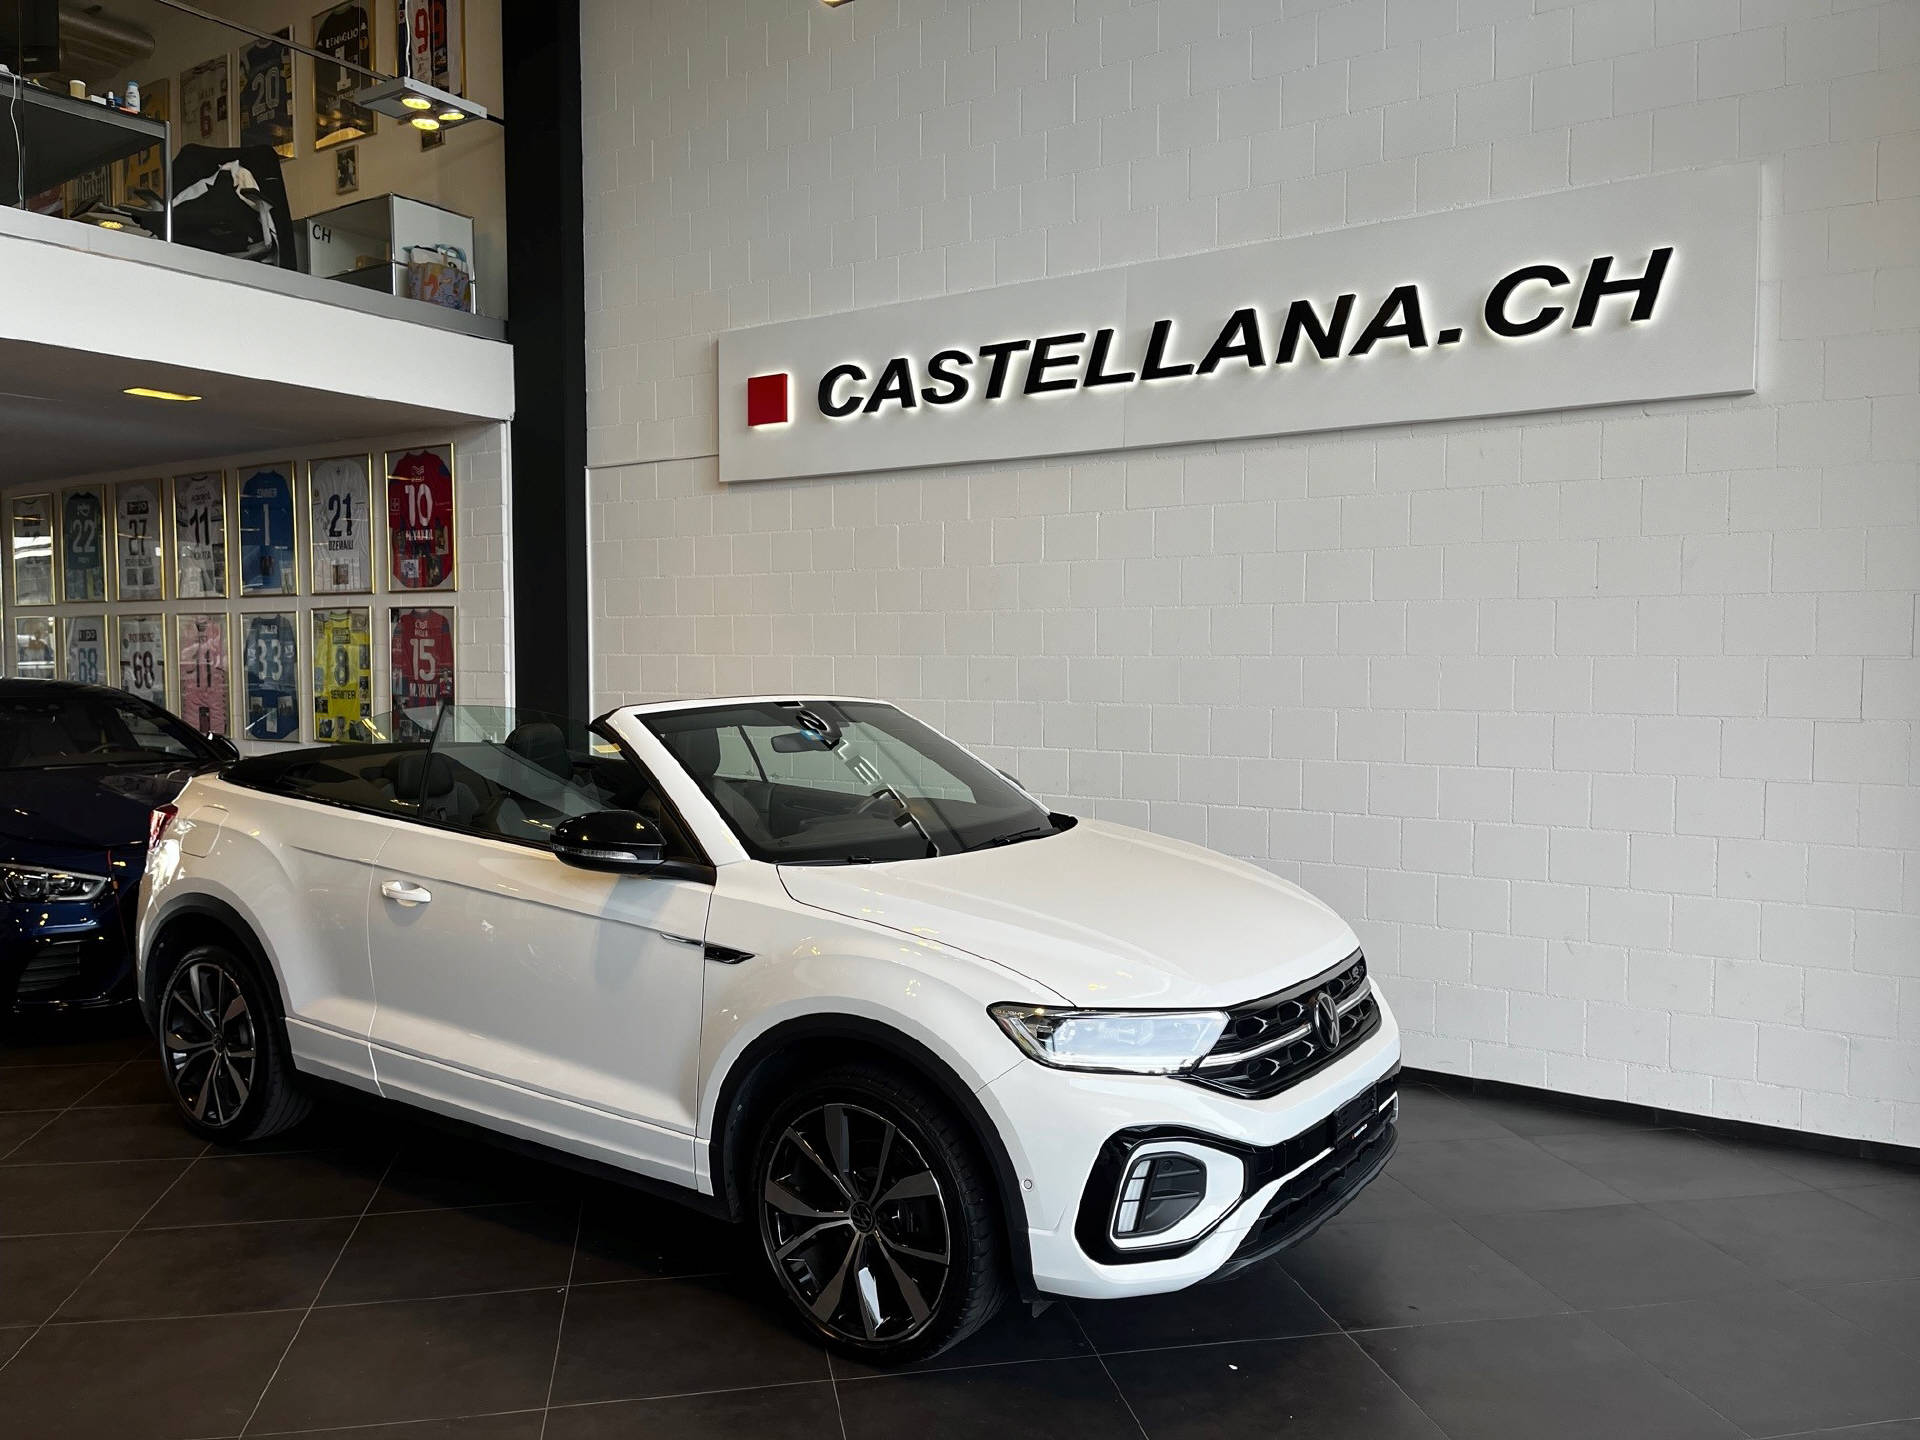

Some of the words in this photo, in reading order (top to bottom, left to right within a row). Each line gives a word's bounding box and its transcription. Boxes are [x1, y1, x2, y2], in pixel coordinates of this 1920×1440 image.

[252, 66, 280, 117] 20
[312, 223, 332, 244] CH
[817, 246, 1674, 418] CASTELLANA.CH
[189, 506, 210, 547] 11
[328, 493, 353, 538] 21
[405, 483, 433, 527] 10
[72, 519, 97, 553] 22
[133, 651, 155, 690] 68
[258, 638, 283, 681] 33
[334, 646, 350, 687] 8
[409, 638, 436, 682] 15
